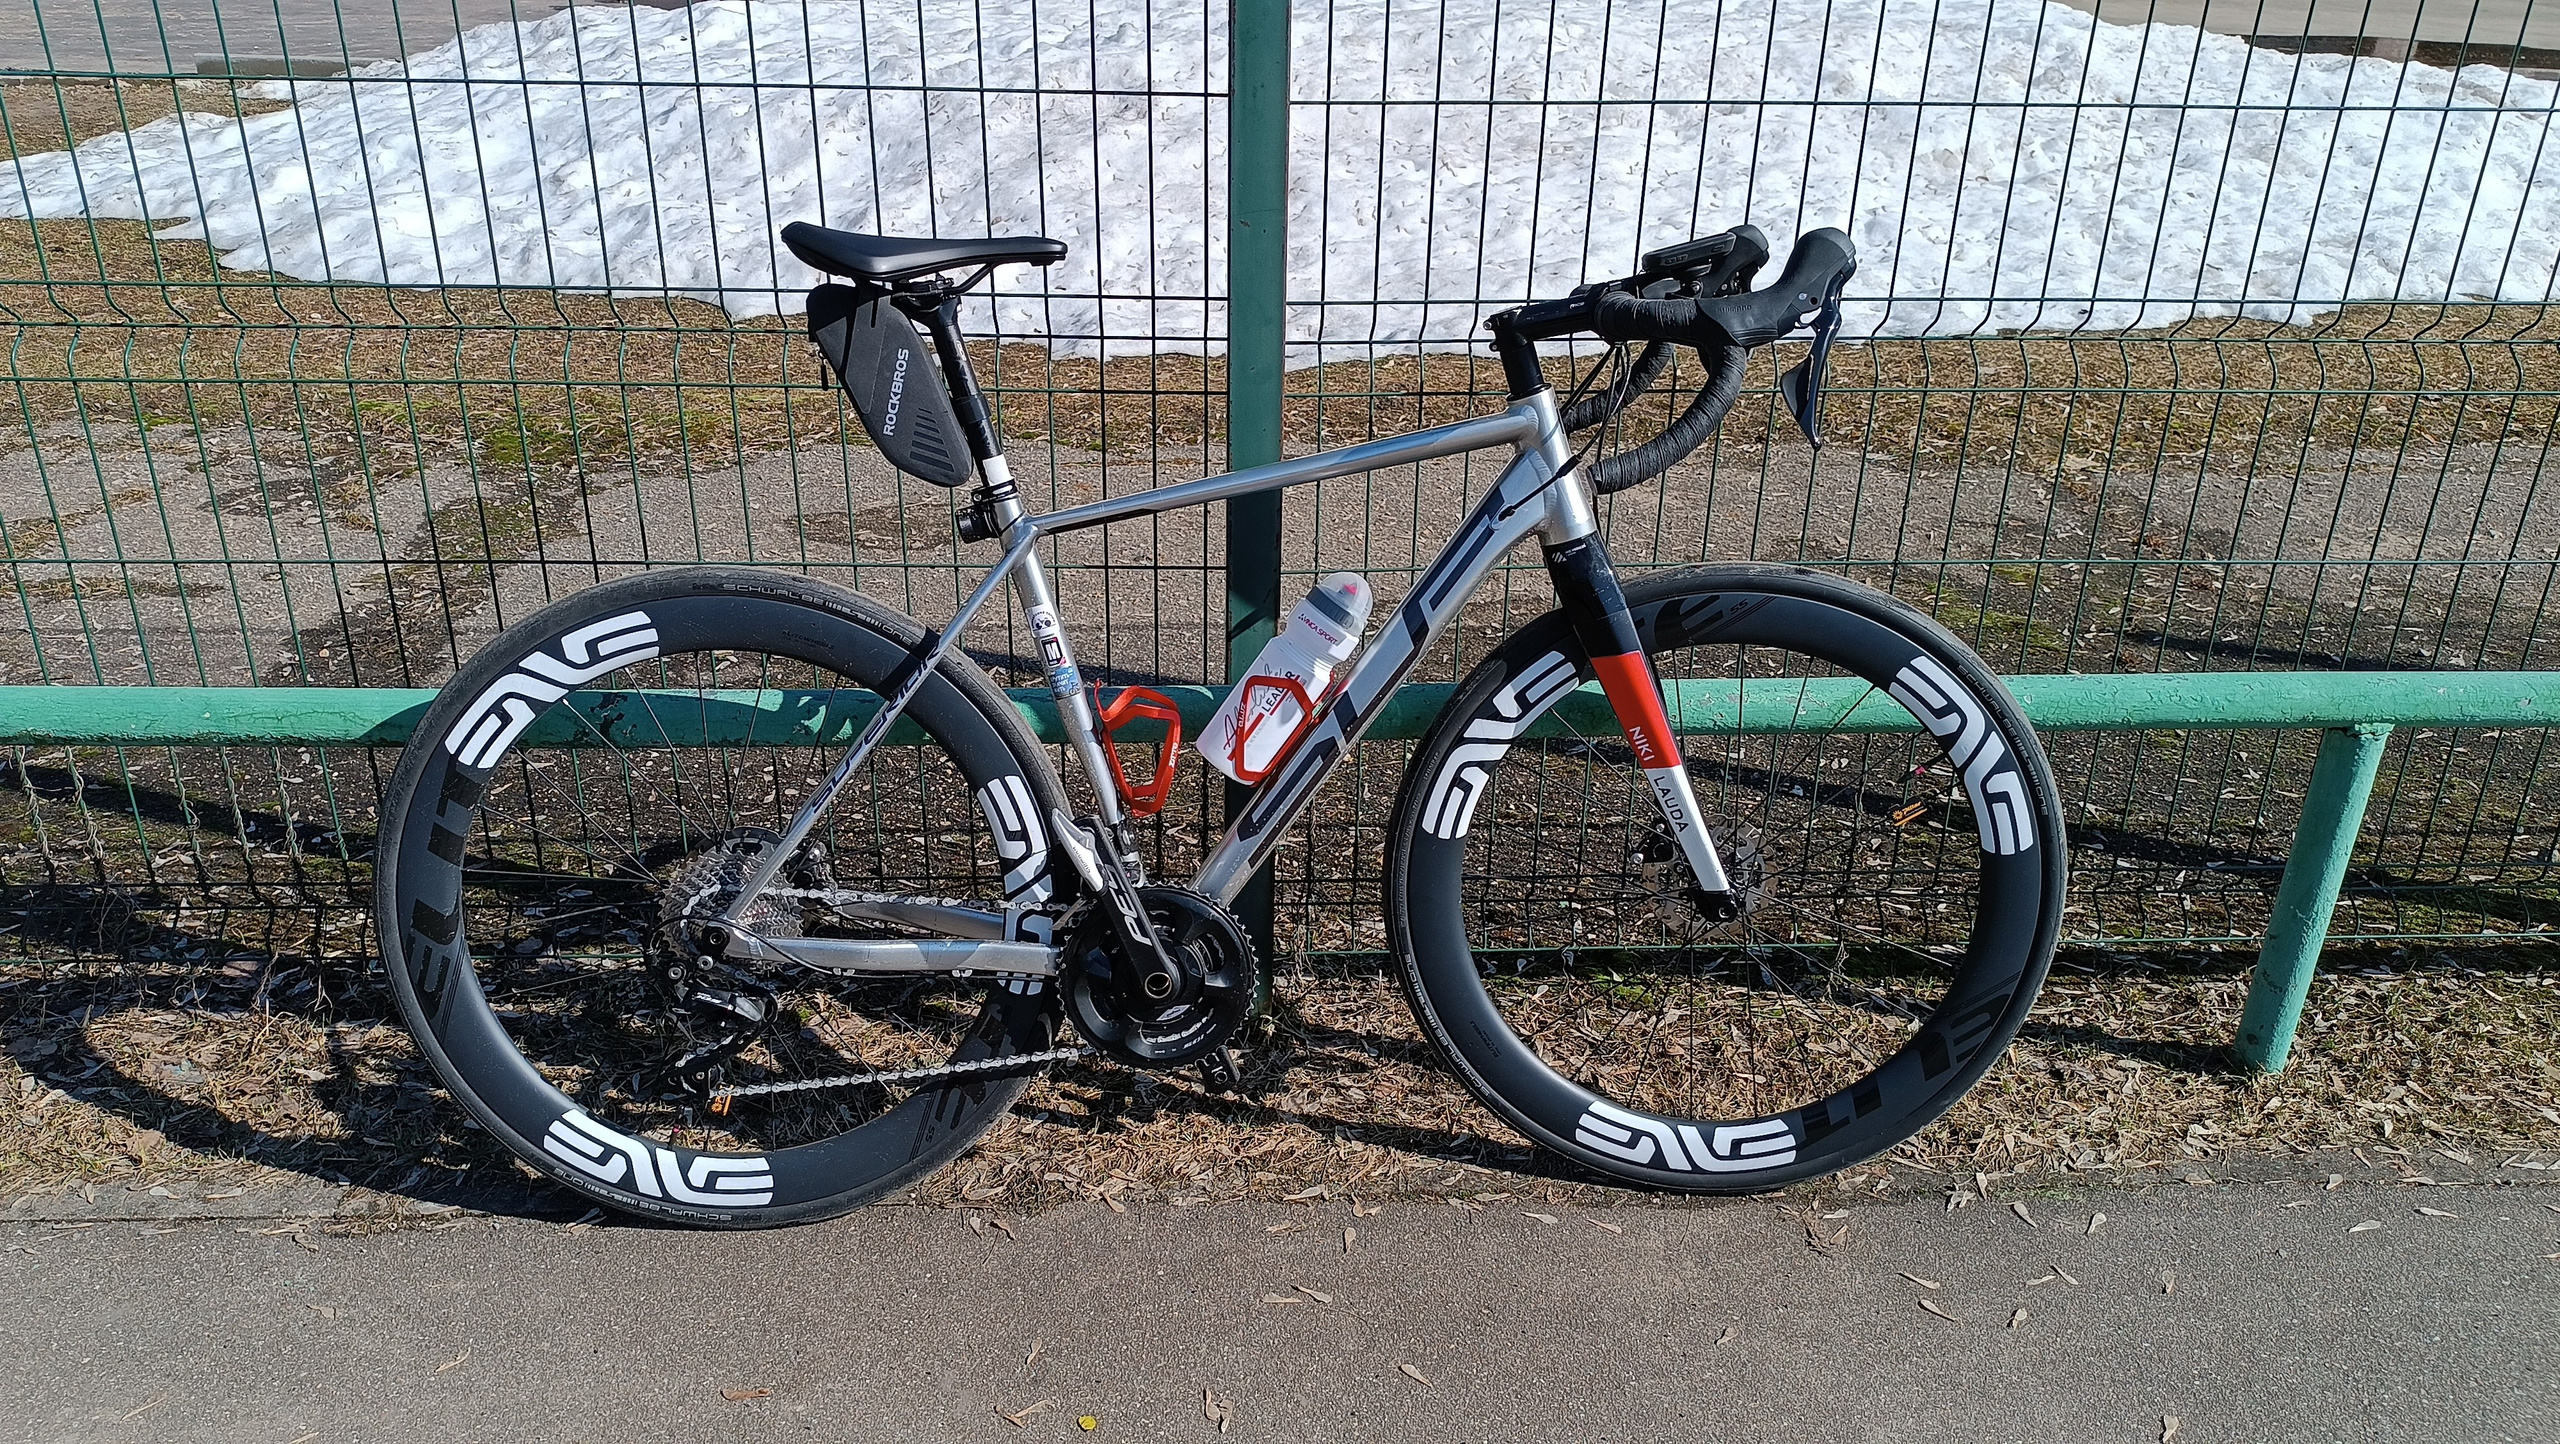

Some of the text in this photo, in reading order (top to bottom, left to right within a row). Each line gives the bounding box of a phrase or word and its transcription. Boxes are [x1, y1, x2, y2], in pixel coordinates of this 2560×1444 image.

[883, 348, 910, 437] ROCKBROS
[722, 583, 914, 646] SCHWALBE ONE
[1317, 629, 1339, 646] SPORT
[1262, 670, 1296, 713] LEADR
[811, 641, 941, 814] SUPERIOR
[1629, 726, 1655, 761] NIKI
[1956, 664, 2049, 816] SCHWALBE ONE
[1653, 775, 1689, 833] LAUDA
[1404, 953, 1417, 982] ONE
[1434, 1027, 1491, 1097] SCHWALBE
[553, 1167, 733, 1222] SCHWALBE ONE
